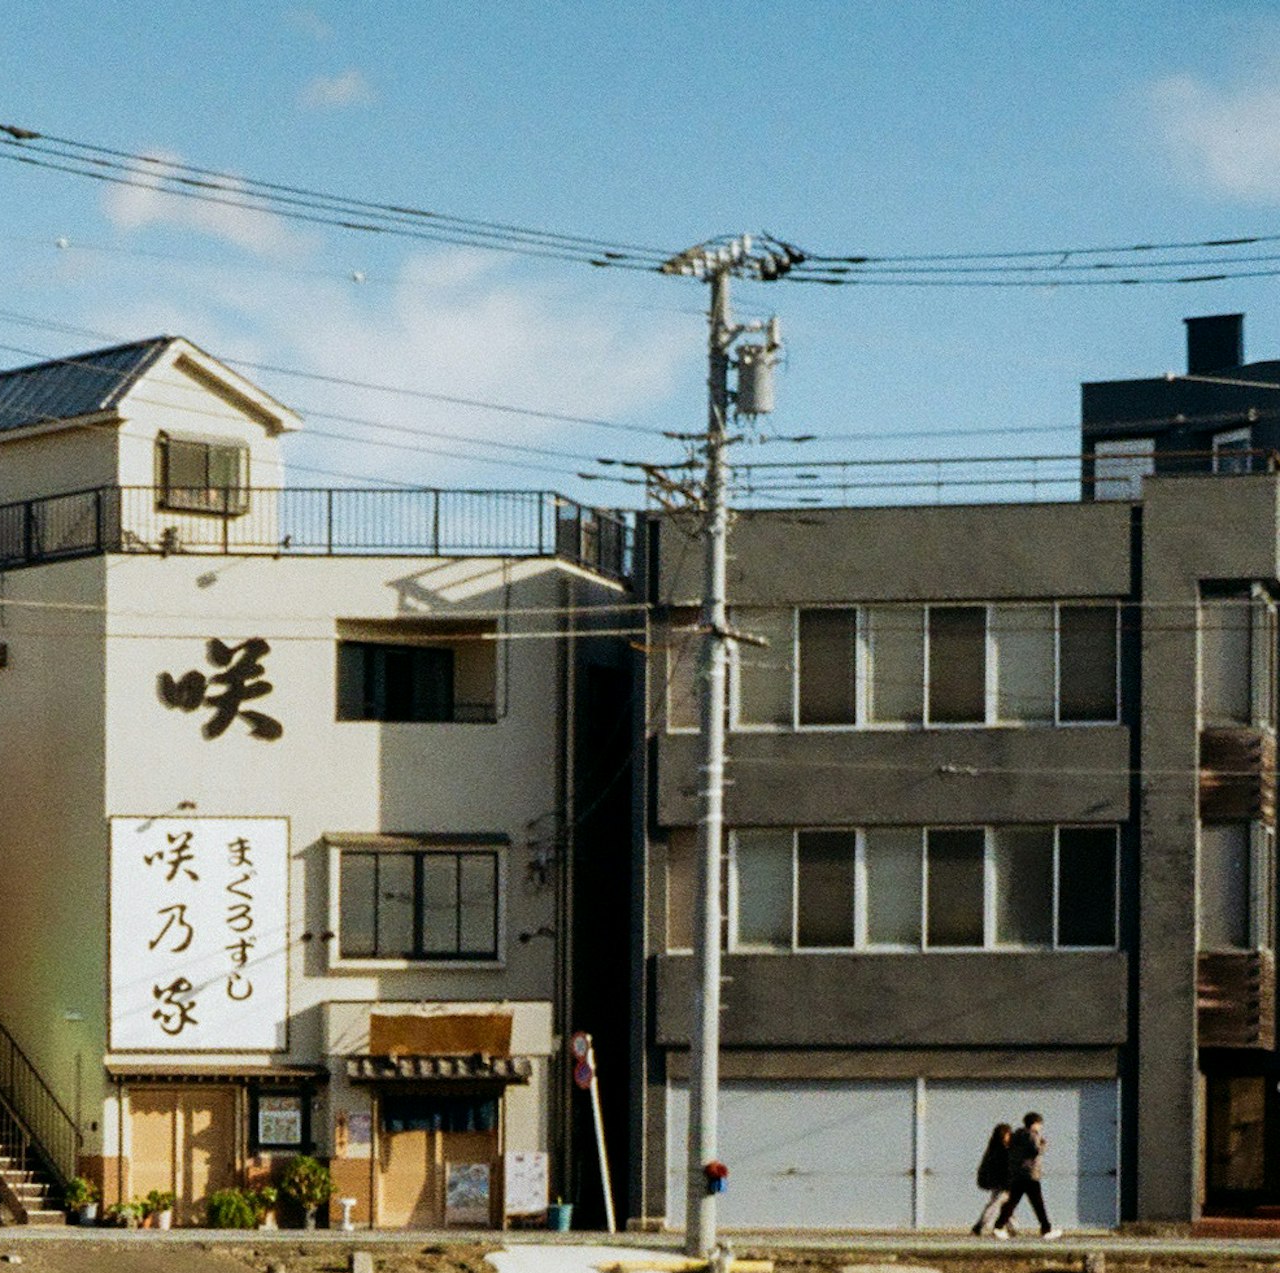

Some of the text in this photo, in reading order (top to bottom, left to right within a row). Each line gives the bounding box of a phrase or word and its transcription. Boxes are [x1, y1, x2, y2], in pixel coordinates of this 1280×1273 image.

[156, 637, 284, 742] 咲
[144, 831, 199, 1036] 咲乃家
[225, 836, 258, 1001] まぐろずし
